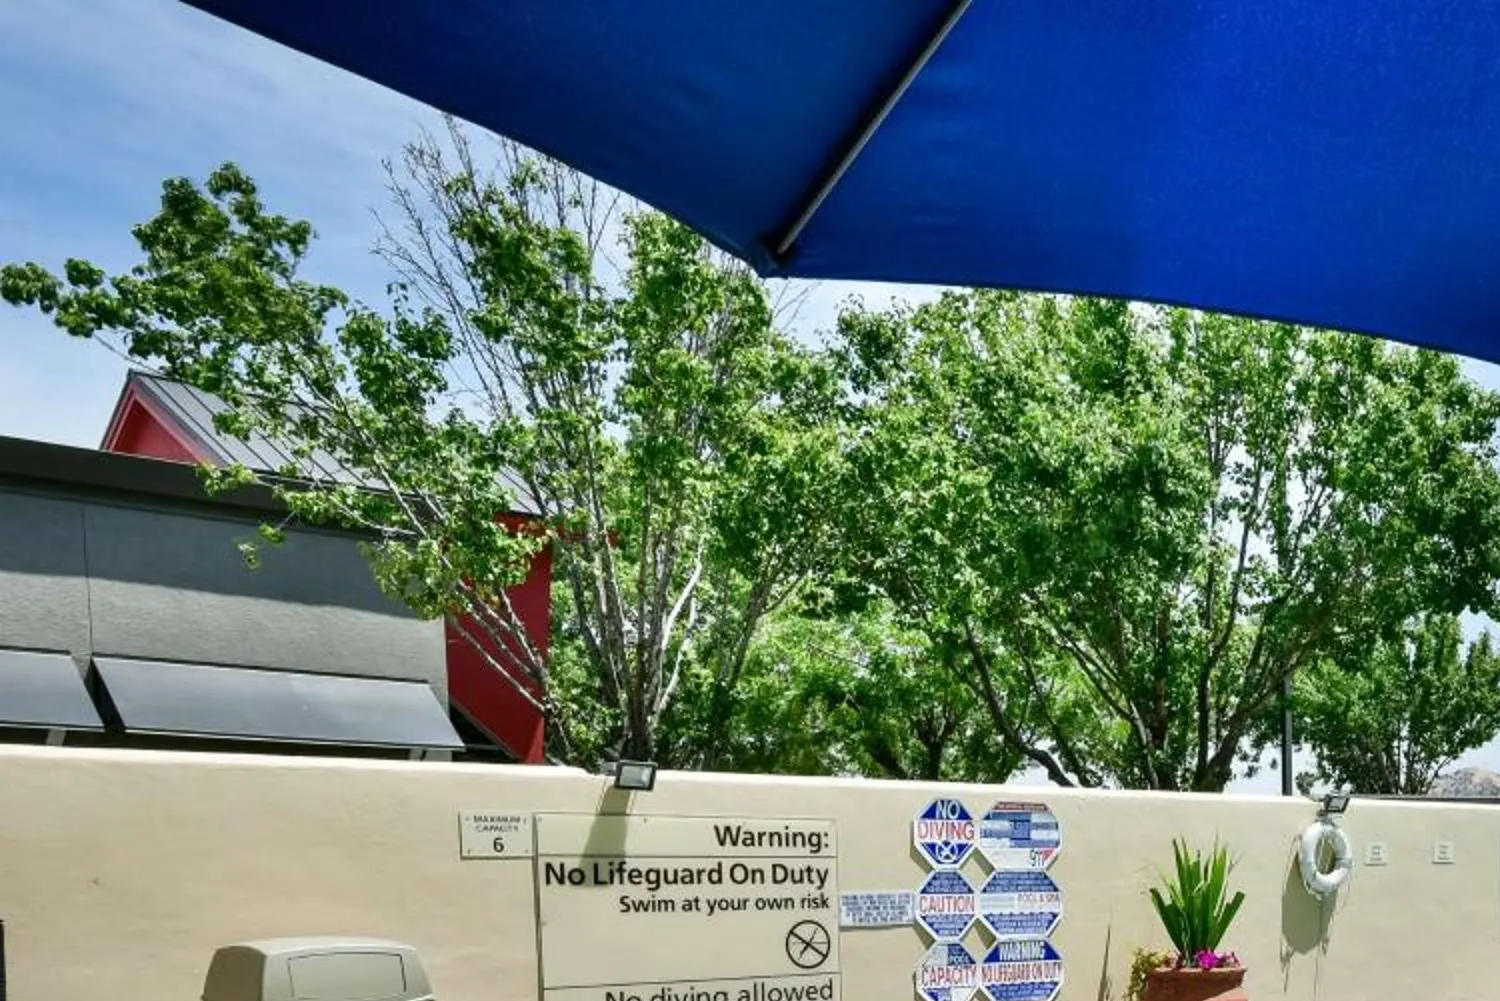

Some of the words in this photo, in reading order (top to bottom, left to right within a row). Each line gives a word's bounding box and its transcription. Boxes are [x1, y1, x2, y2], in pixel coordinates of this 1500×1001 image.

[935, 799, 961, 819] NO
[713, 824, 829, 854] Warning:
[917, 821, 975, 840] DIVING
[493, 836, 505, 853] 6
[544, 861, 586, 886] No
[593, 861, 723, 891] Lifeguard
[729, 862, 765, 885] On
[771, 862, 829, 890] Duty
[619, 894, 676, 912] Swim
[682, 896, 701, 912] at
[706, 898, 749, 917] your
[755, 897, 795, 911] own
[801, 892, 830, 909] risk
[919, 895, 975, 913] CAUTION
[999, 941, 1046, 961] WARNING
[921, 965, 977, 986] CAPACITY
